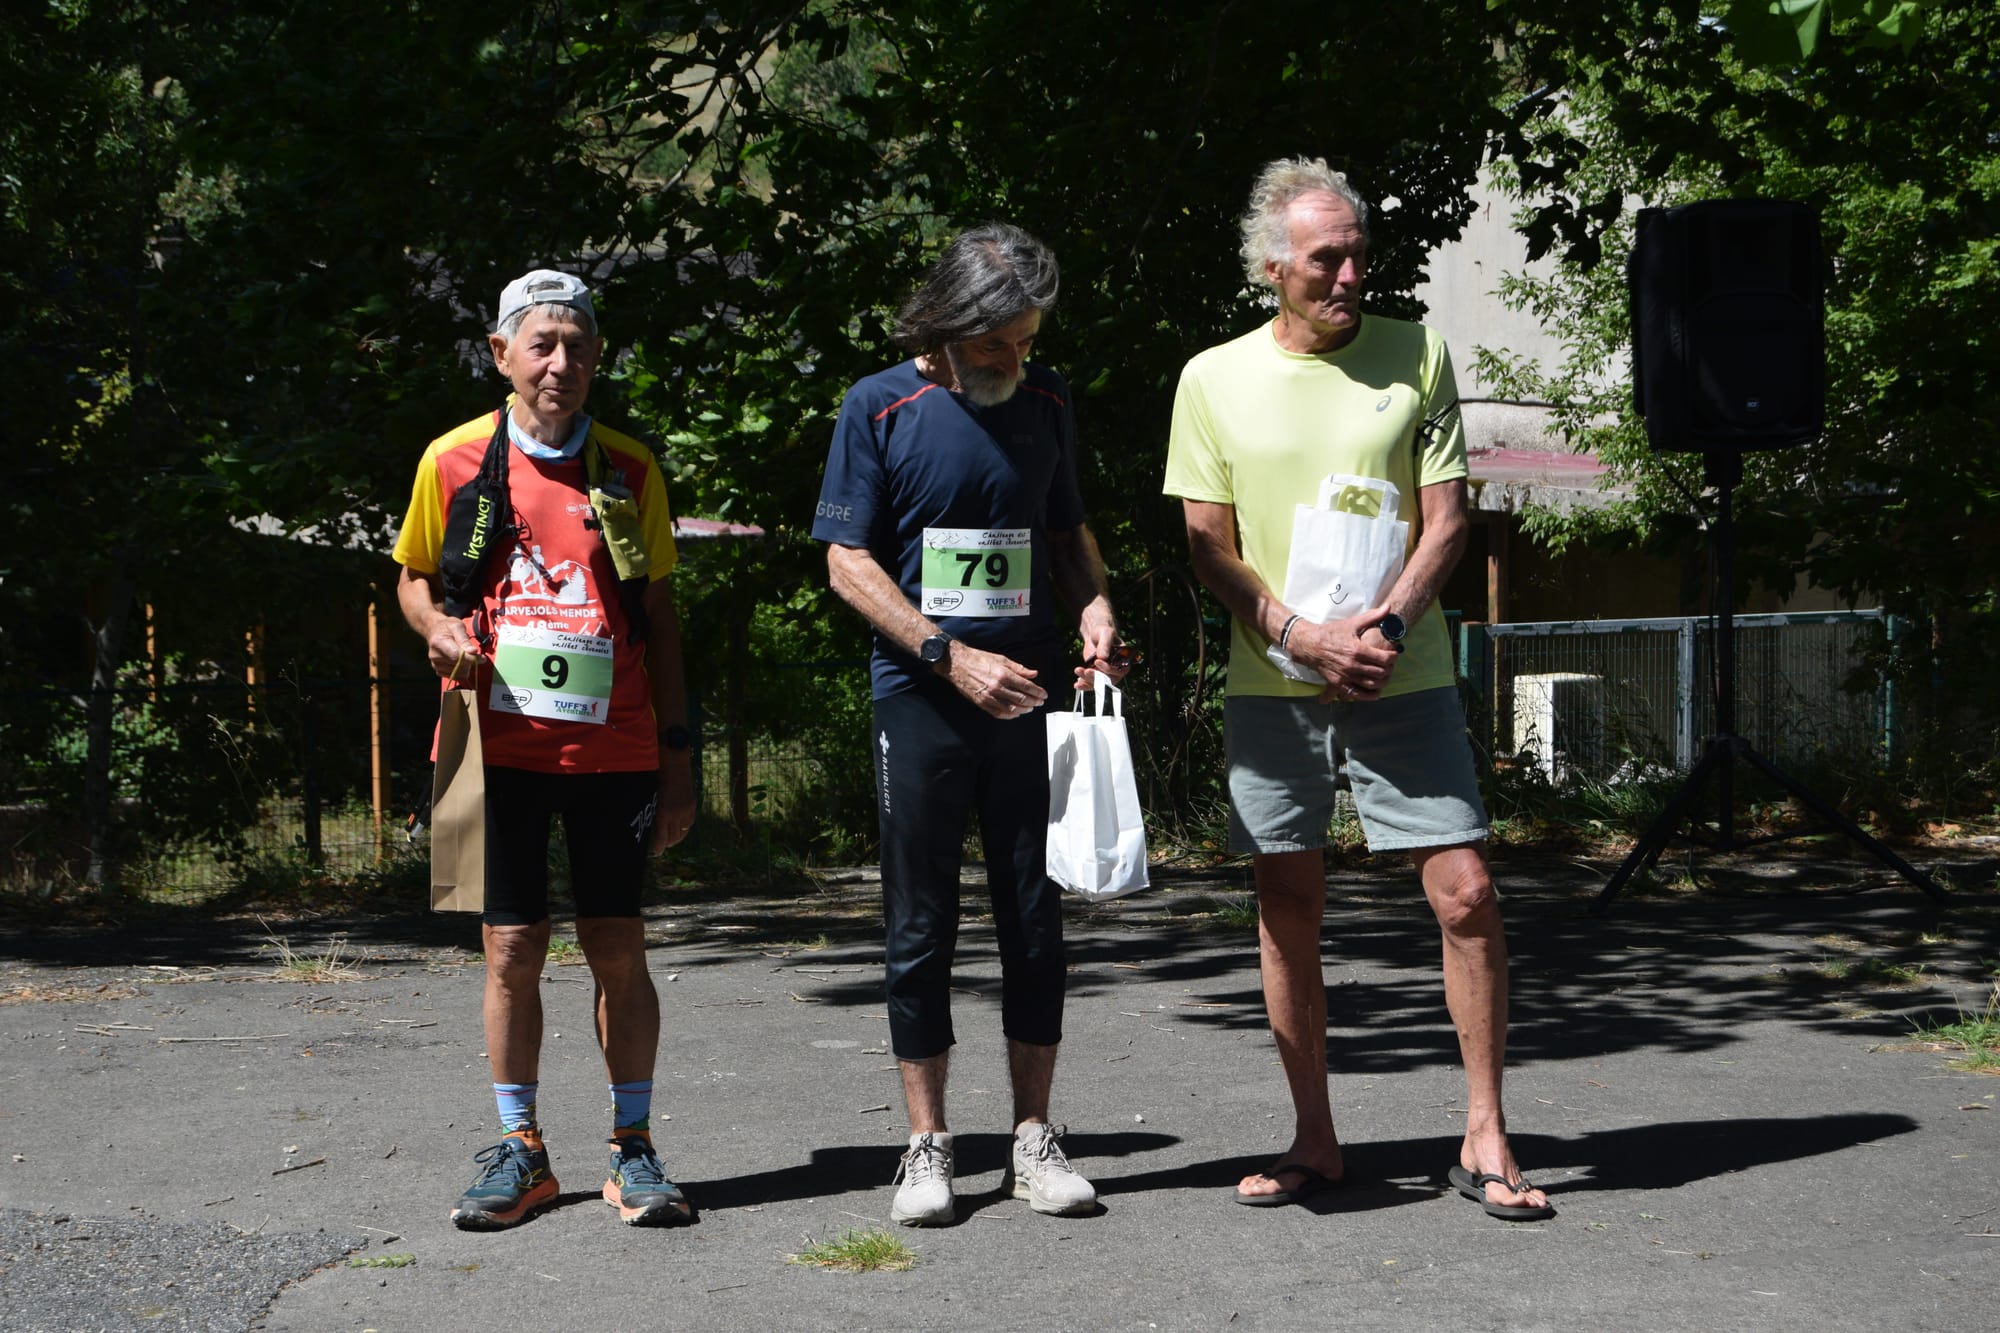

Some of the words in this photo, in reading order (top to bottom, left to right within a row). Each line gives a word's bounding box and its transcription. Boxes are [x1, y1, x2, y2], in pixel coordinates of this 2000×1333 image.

[816, 501, 852, 521] GORE
[956, 553, 1009, 587] 79
[985, 597, 1016, 606] TUFF'S
[559, 608, 597, 618] MENDE
[541, 655, 569, 689] 9
[554, 700, 588, 711] TUFF'S
[882, 756, 892, 815] RAIDLIGHT
